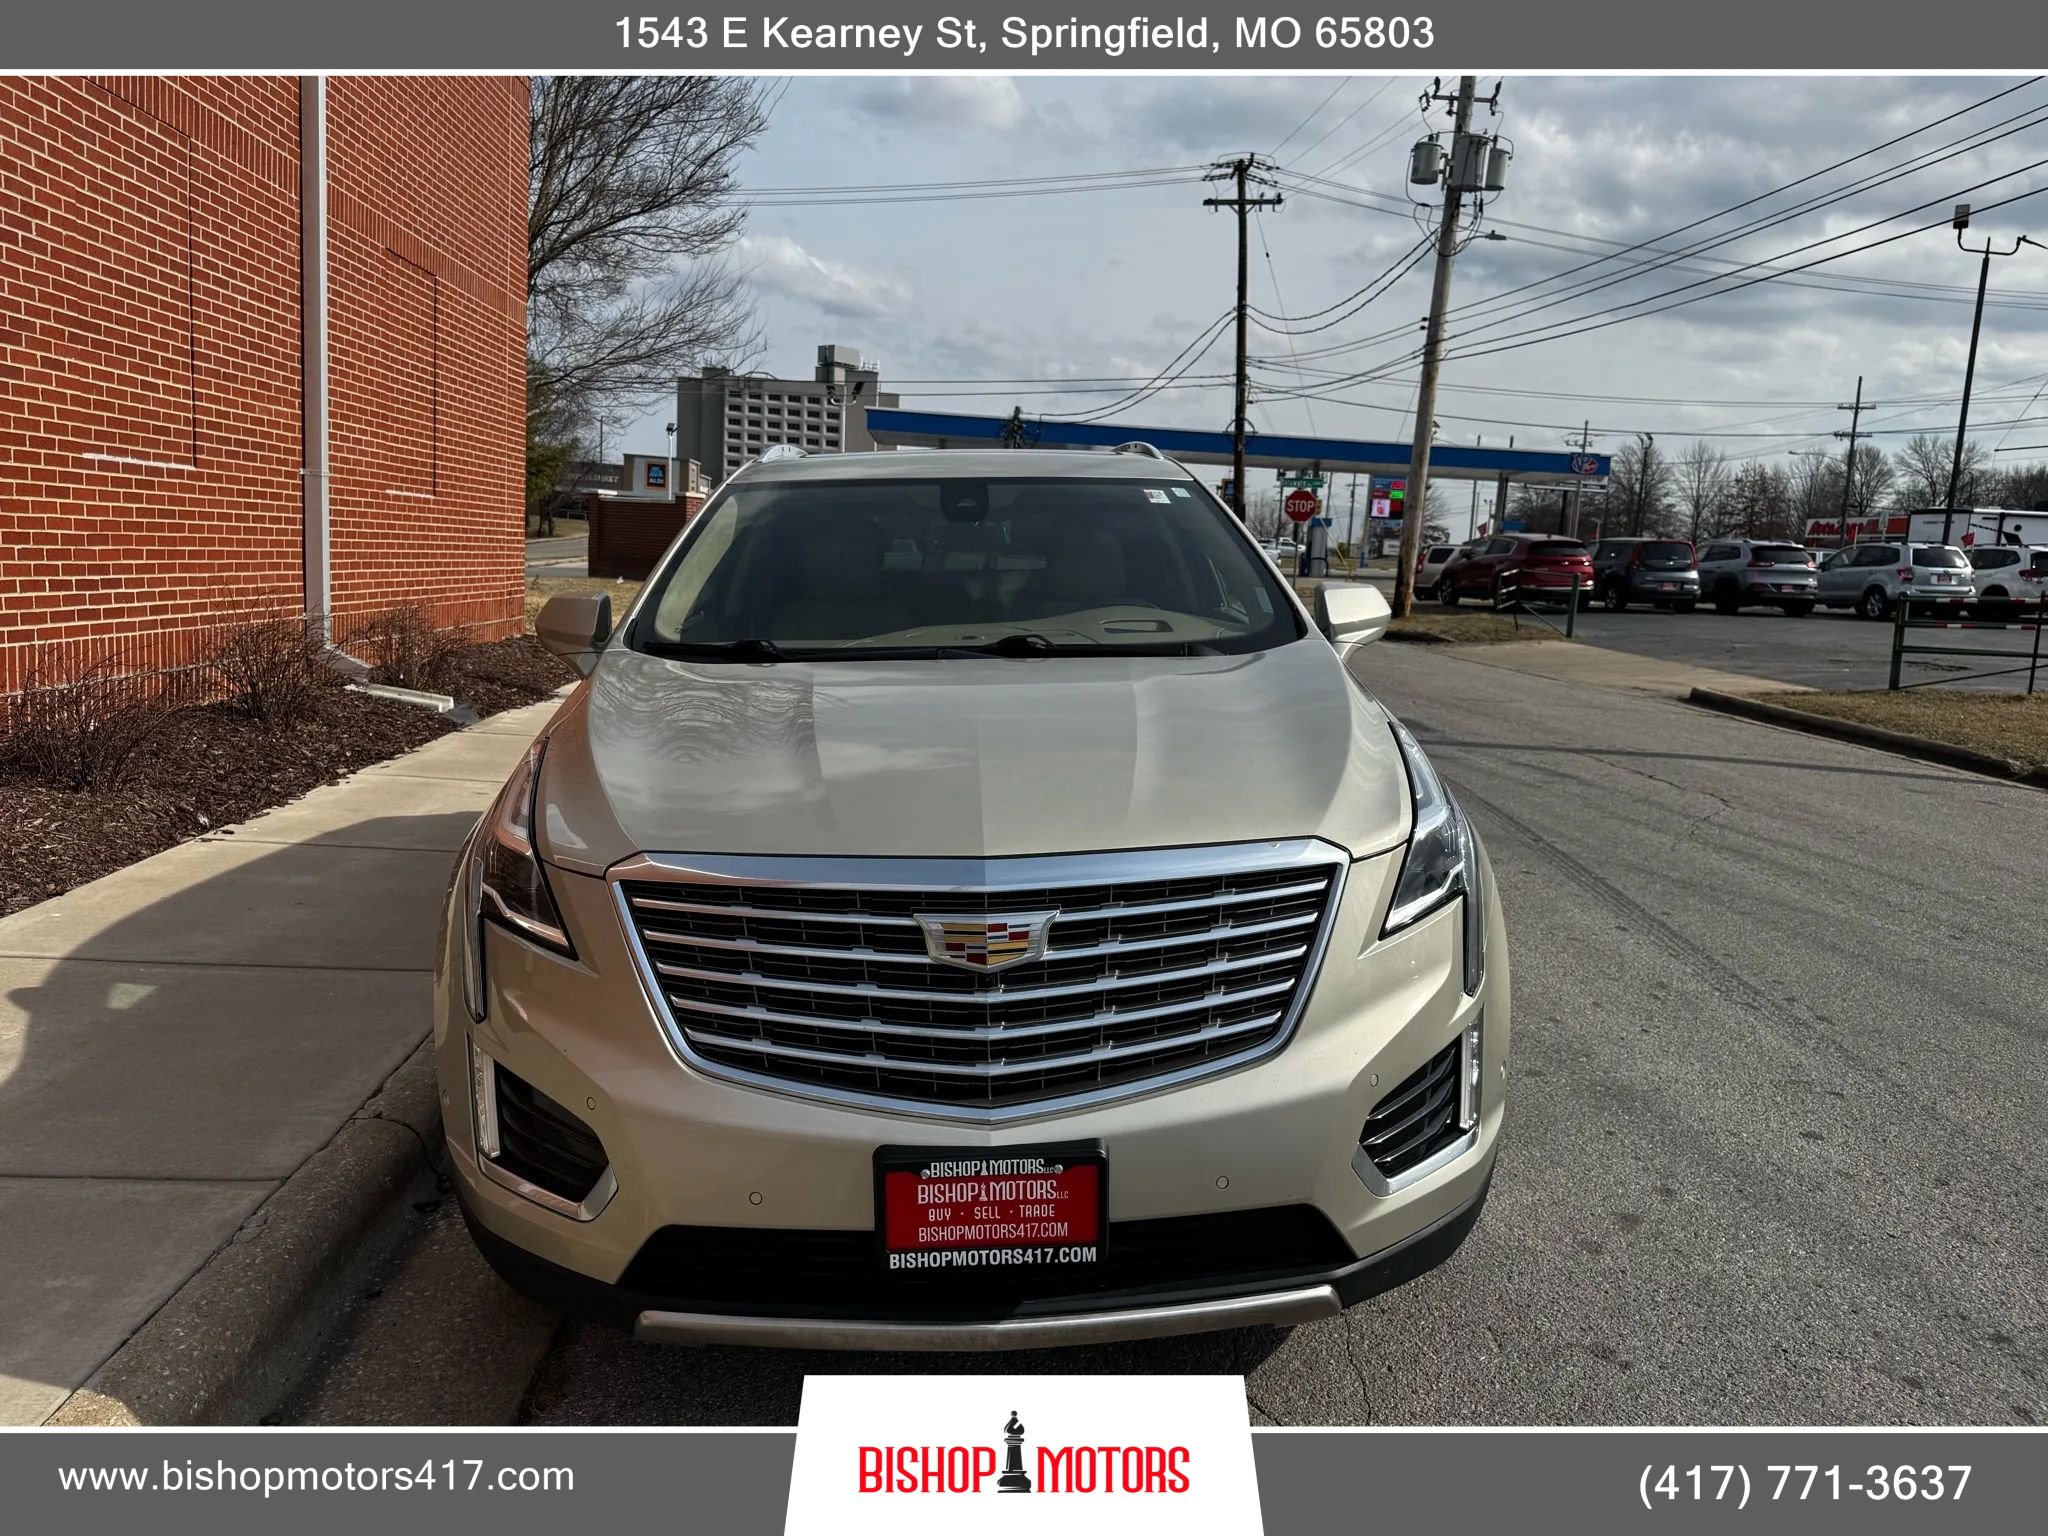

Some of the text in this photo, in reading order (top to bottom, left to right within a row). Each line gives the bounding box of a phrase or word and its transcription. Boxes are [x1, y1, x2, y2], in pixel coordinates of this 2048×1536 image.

[1287, 500, 1315, 512] STOP
[931, 1161, 981, 1178] BISHOP
[989, 1158, 1045, 1176] MOTORS
[917, 1180, 1069, 1204] BISHOP MOTORS LLC
[928, 1204, 1056, 1222] BUY SELL TRADE
[918, 1222, 1068, 1242] BISHOPMOTORS417.COM
[889, 1248, 1097, 1269] BISHOPMOTORS417.COM
